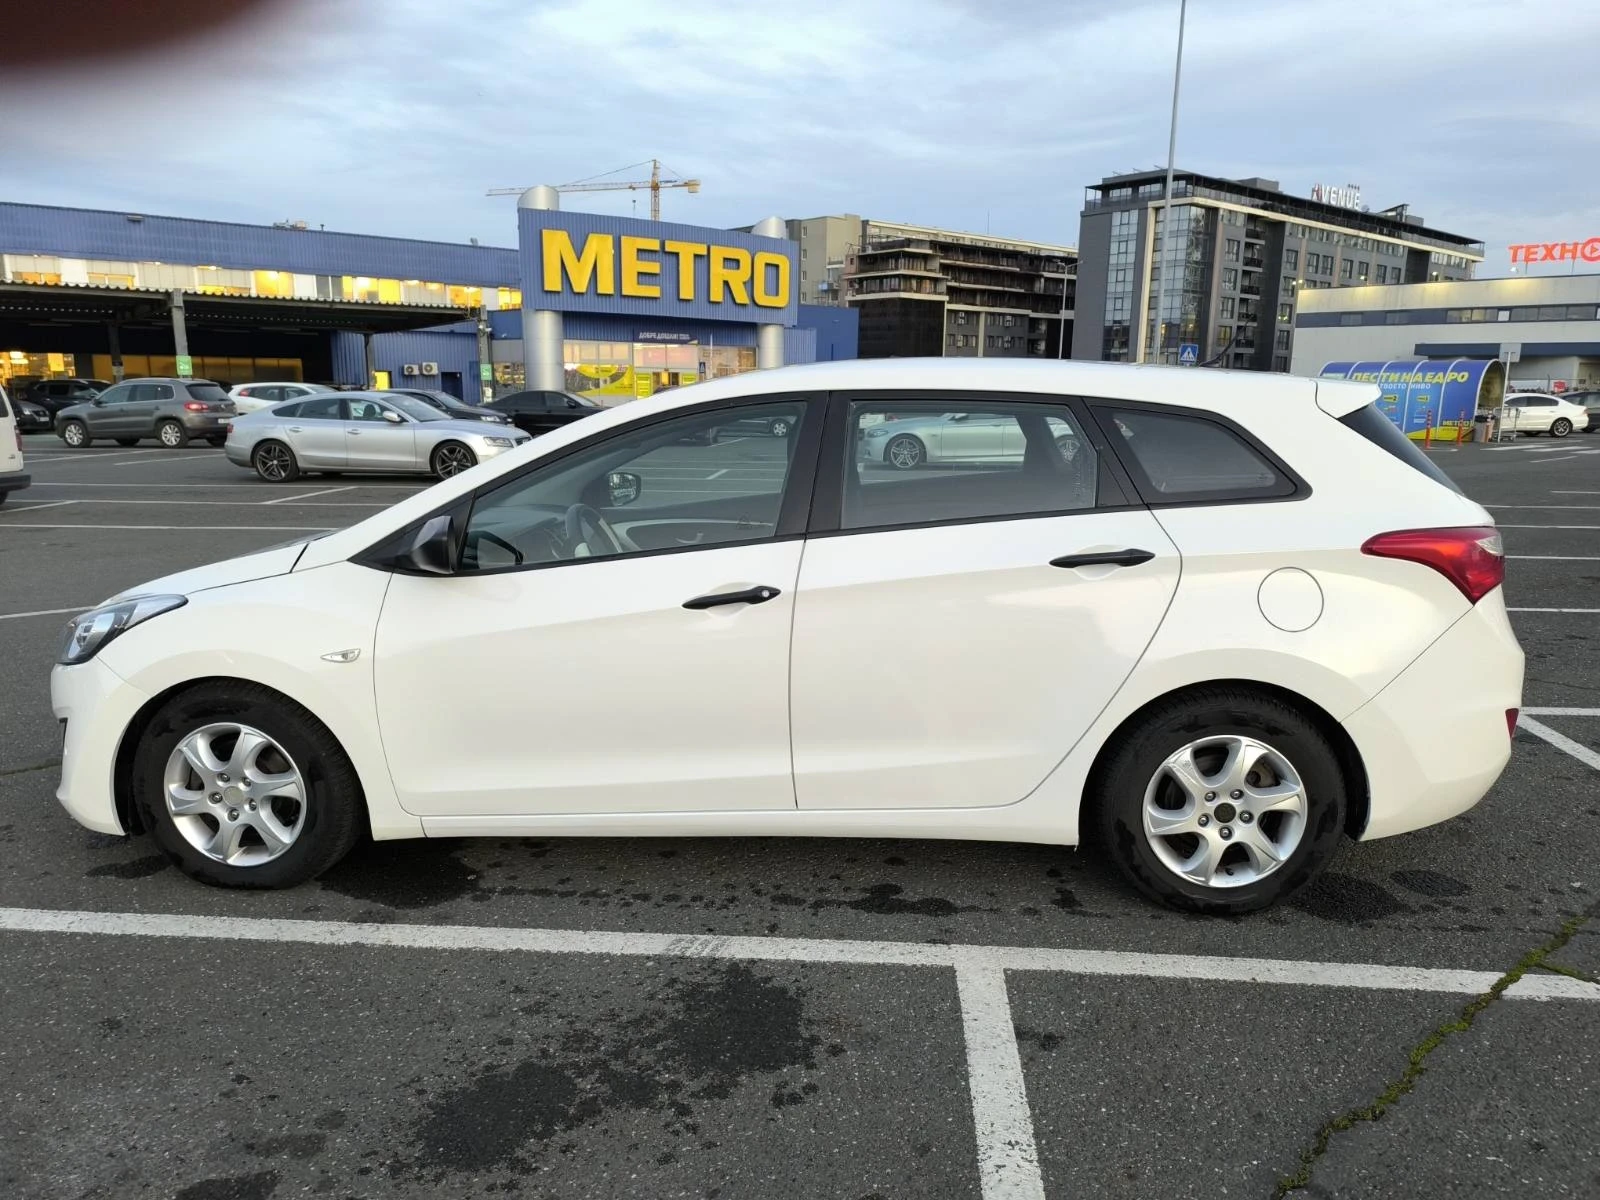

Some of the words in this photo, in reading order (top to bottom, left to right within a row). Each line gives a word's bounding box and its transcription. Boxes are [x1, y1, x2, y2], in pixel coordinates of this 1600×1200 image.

[542, 229, 790, 308] METRO
[1401, 371, 1423, 383] НА
[1424, 371, 1469, 384] ЕДРО
